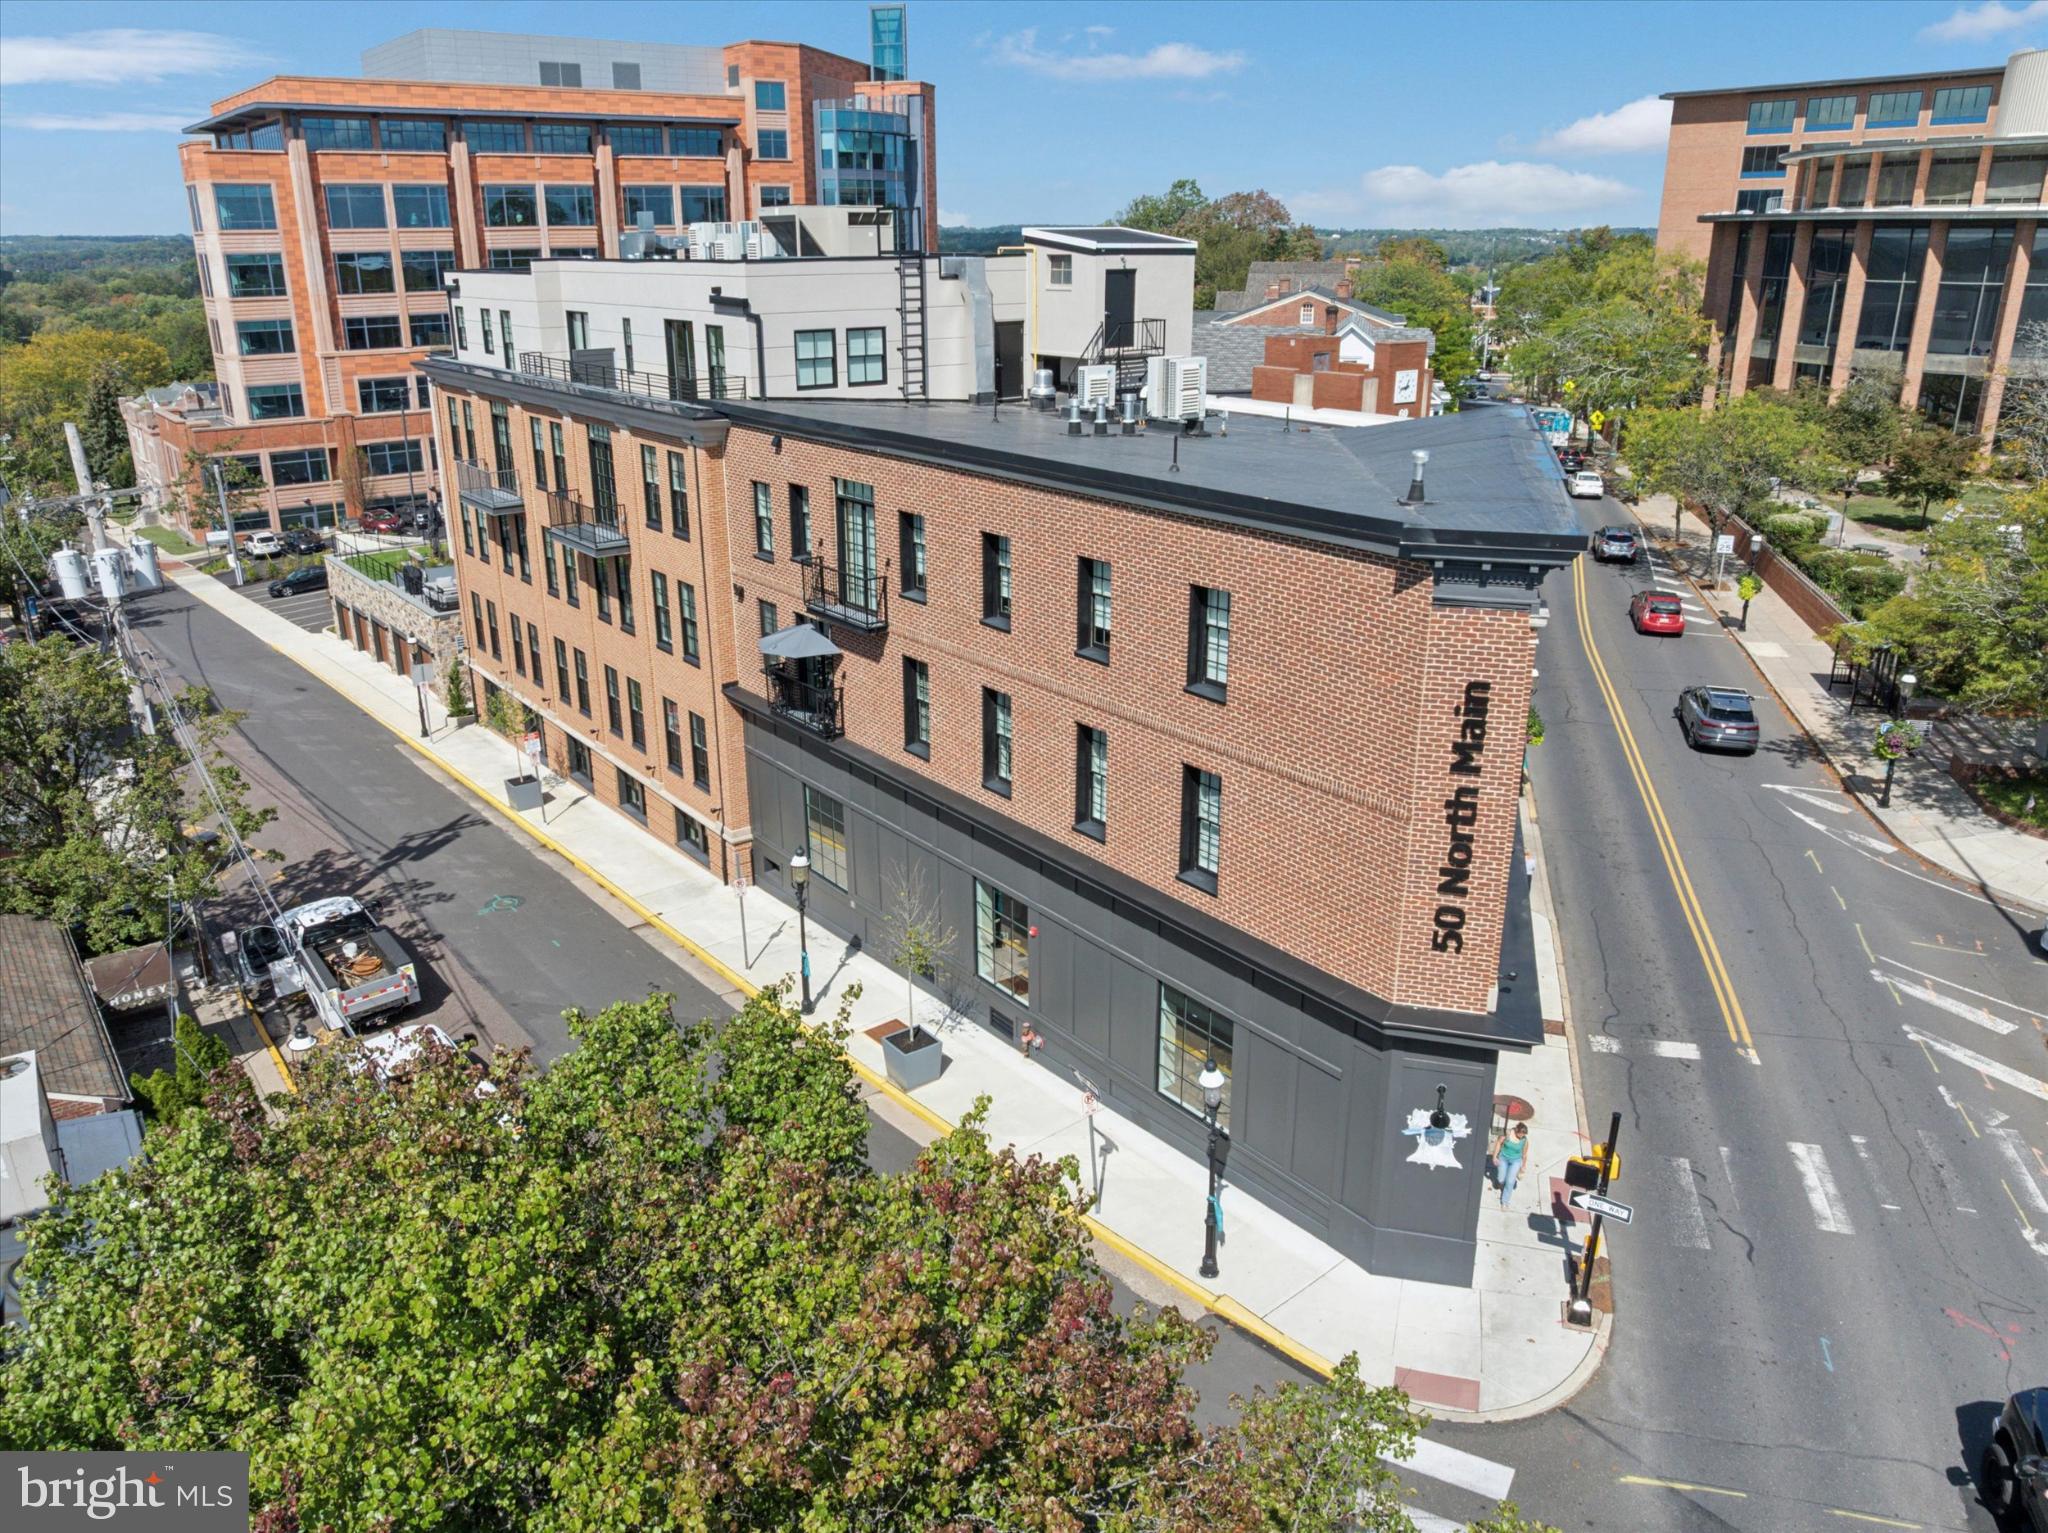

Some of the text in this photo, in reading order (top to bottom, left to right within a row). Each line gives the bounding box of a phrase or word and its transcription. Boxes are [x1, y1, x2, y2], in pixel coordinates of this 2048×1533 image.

[1431, 681, 1491, 954] 50 North Main
[1589, 1200, 1625, 1216] ONE WAY
